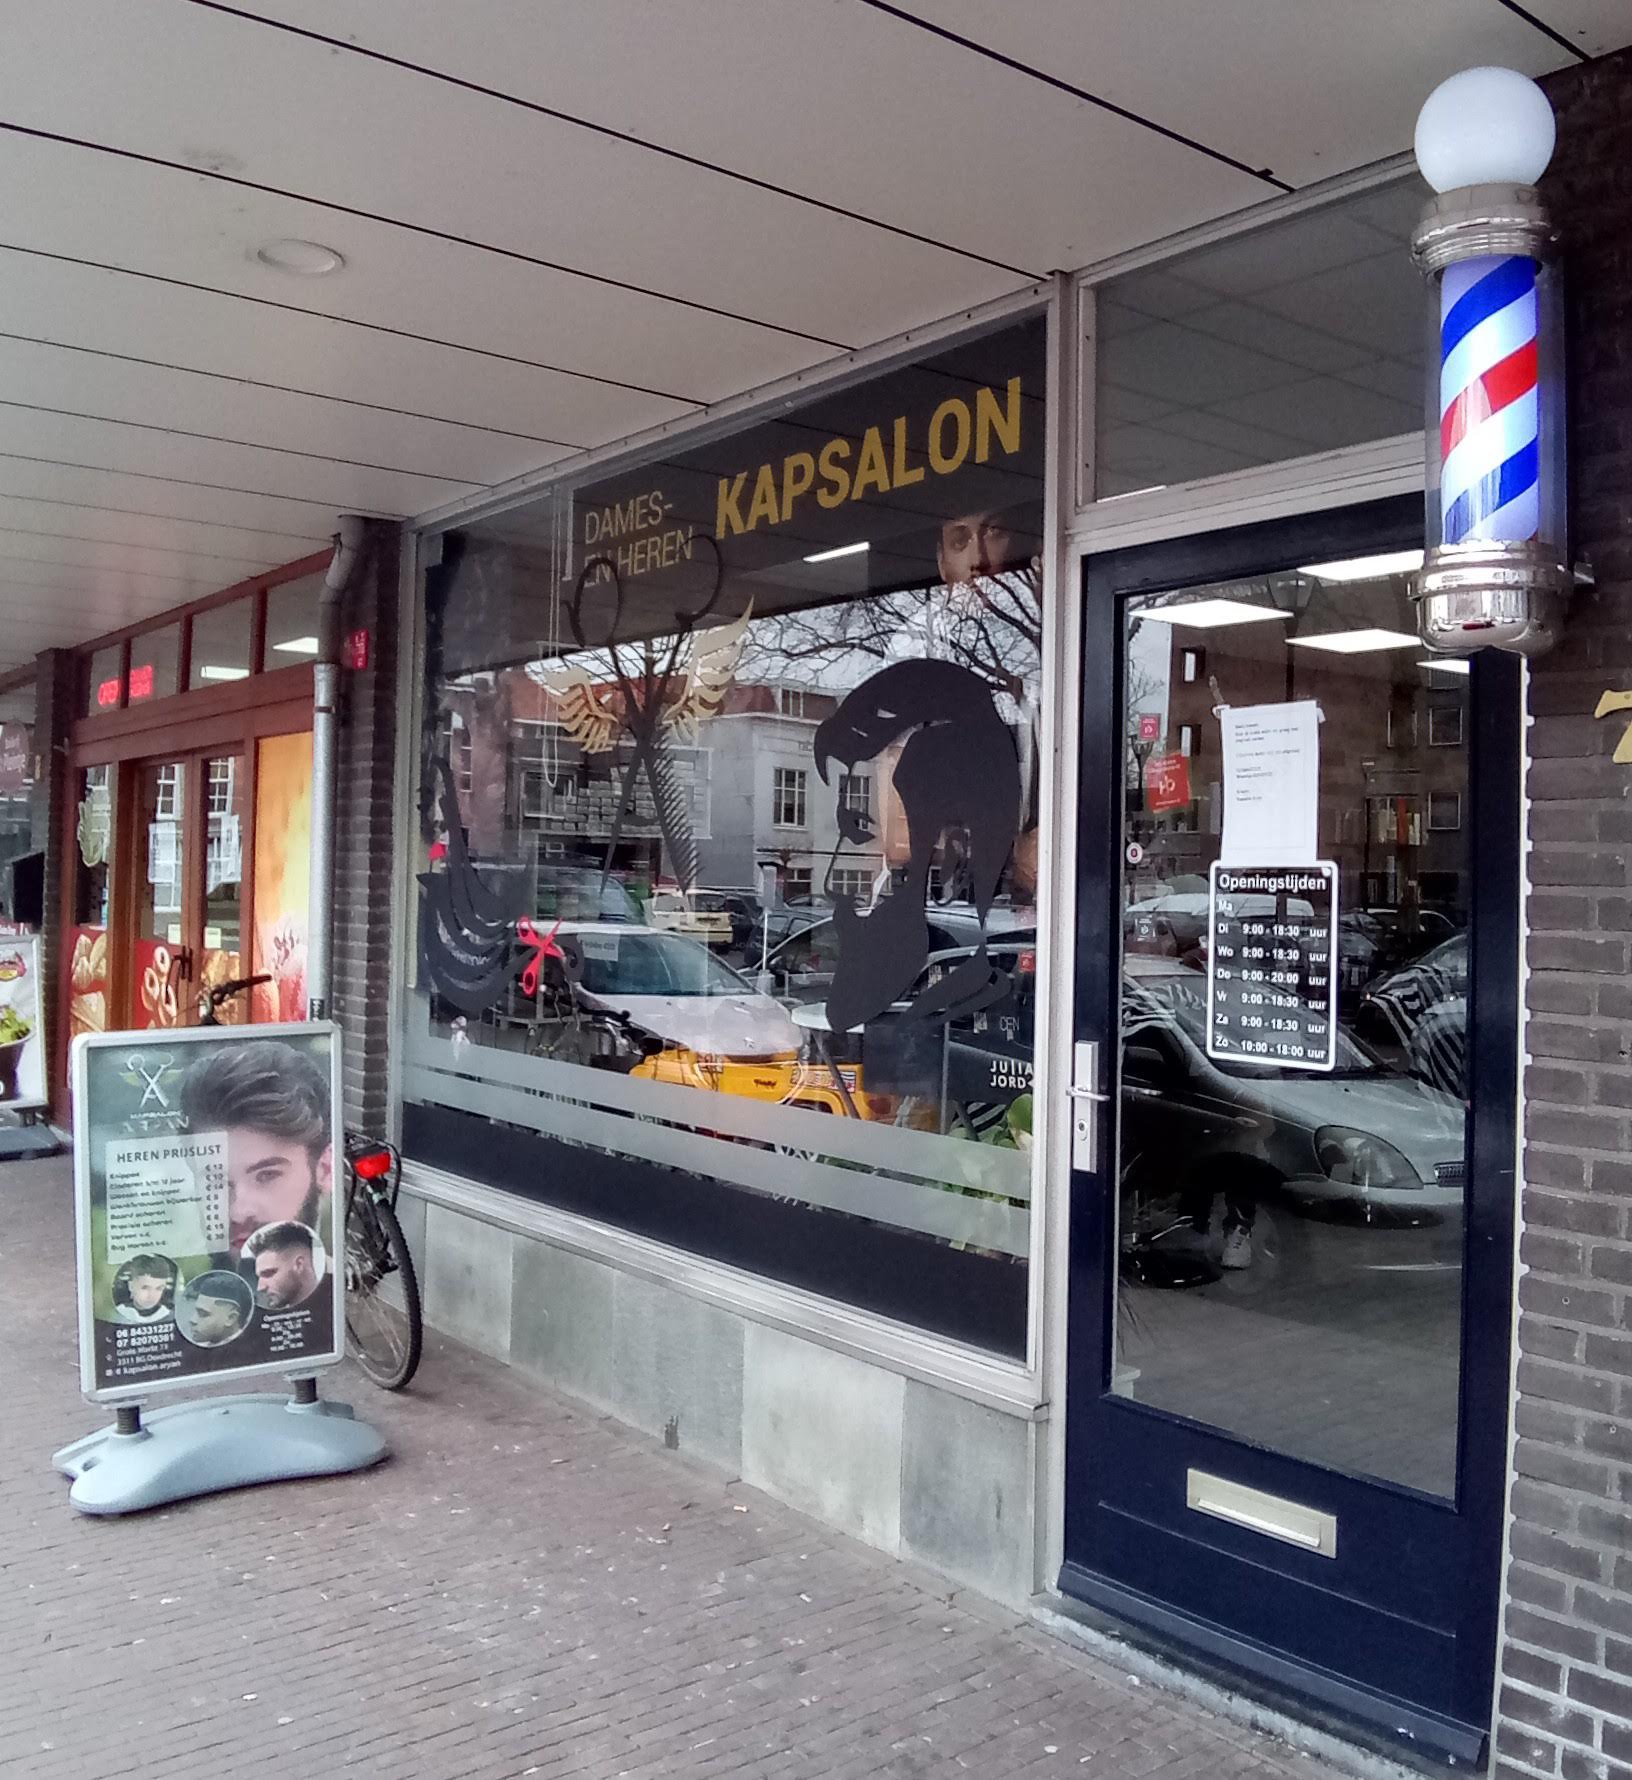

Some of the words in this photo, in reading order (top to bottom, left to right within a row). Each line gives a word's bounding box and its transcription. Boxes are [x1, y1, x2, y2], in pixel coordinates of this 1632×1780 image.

[715, 376, 1021, 540] KAPSALON
[585, 490, 673, 545] DAMES-
[618, 525, 693, 577] HEREN
[1219, 874, 1326, 893] Openingstijden
[1218, 923, 1229, 934] Di
[1242, 923, 1264, 935] 9:00
[1272, 924, 1299, 937] 18:30
[1309, 928, 1328, 938] uur
[1217, 946, 1234, 958] Wo
[1242, 947, 1264, 959] 9:00
[1272, 948, 1299, 960] 18:30
[1309, 952, 1327, 962] uur
[1216, 968, 1231, 980] Do
[1241, 970, 1264, 981] 9:00
[1270, 972, 1299, 984] 20:00
[1308, 976, 1327, 986] uur
[1216, 991, 1227, 1002] Vr
[1241, 993, 1263, 1005] 9:00
[1271, 995, 1298, 1007] 18:30
[1308, 1000, 1326, 1010] uur
[1216, 1013, 1229, 1025] Za
[1240, 1016, 1262, 1028] 9:00
[1270, 1018, 1298, 1031] 18:30
[1307, 1023, 1326, 1033] uur
[1215, 1035, 1229, 1048] Zo
[1240, 1040, 1267, 1053] 10:00
[1276, 1044, 1304, 1057] 18:00
[1307, 1049, 1326, 1059] uur
[117, 1149, 160, 1163] HEREN
[163, 1144, 221, 1159] PRIJSLIST
[116, 1329, 128, 1338] 06
[116, 1339, 128, 1348] 07
